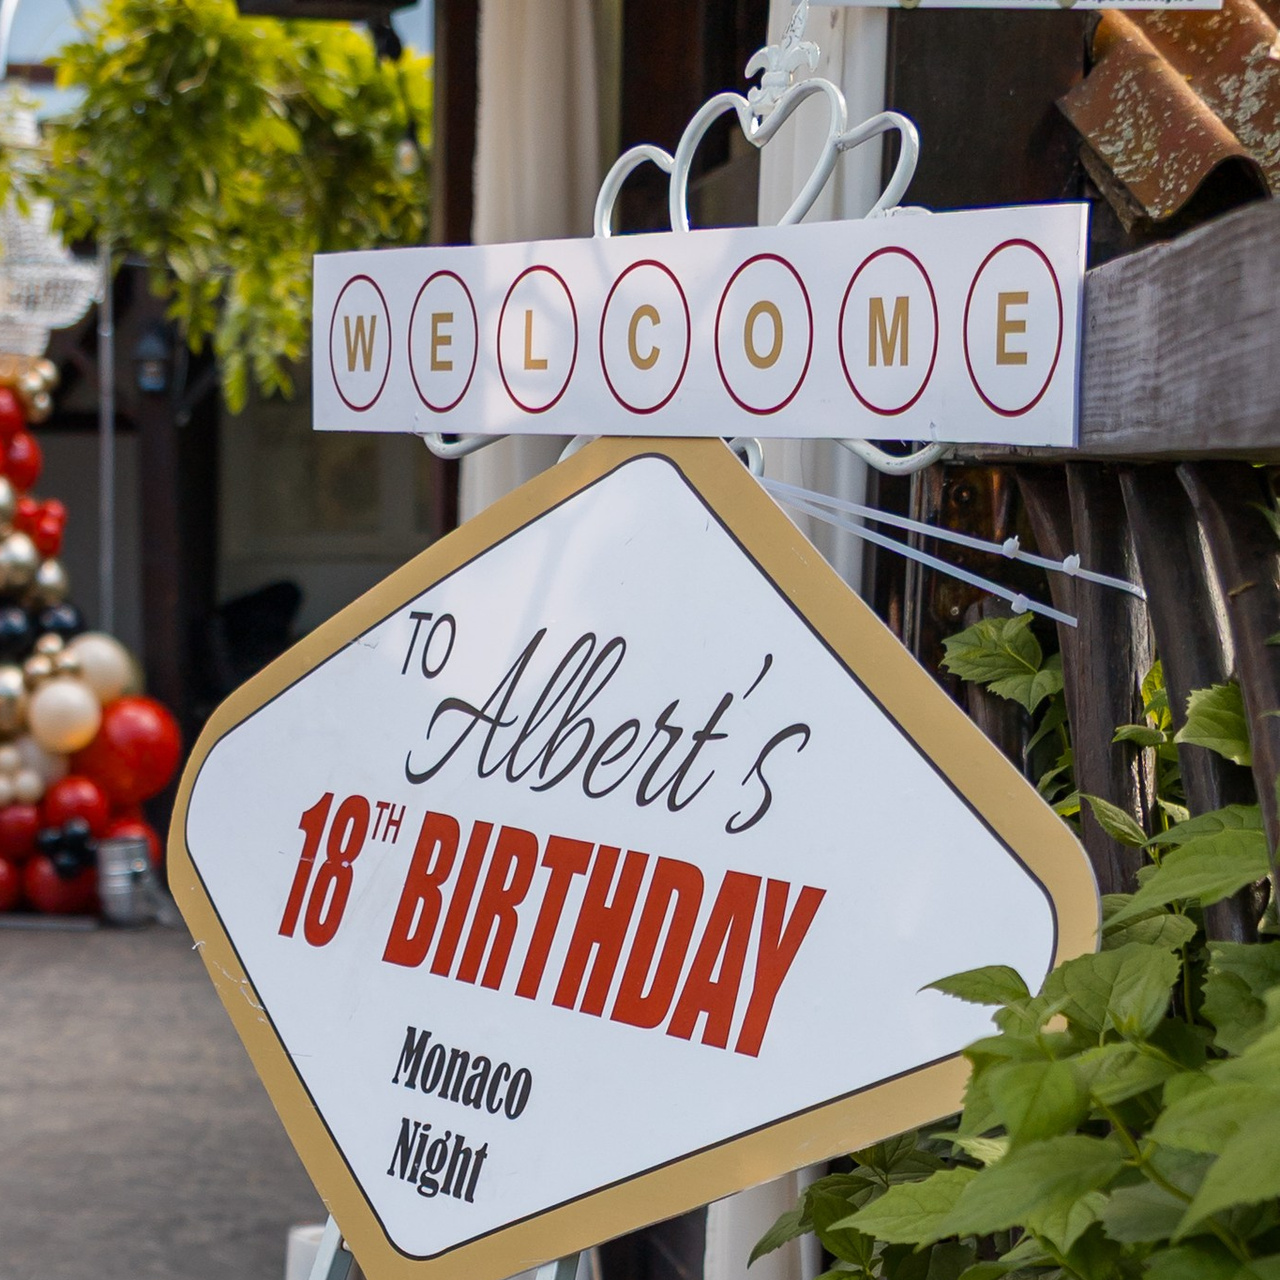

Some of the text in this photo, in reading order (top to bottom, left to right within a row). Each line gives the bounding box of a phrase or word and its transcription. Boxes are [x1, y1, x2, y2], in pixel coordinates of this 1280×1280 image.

[344, 291, 1029, 372] WELCOME
[402, 611, 457, 680] TO
[405, 628, 812, 834] Albert's
[382, 811, 827, 1059] BIRTHDAY
[392, 1026, 533, 1121] Monaco
[386, 1117, 488, 1204] Night
